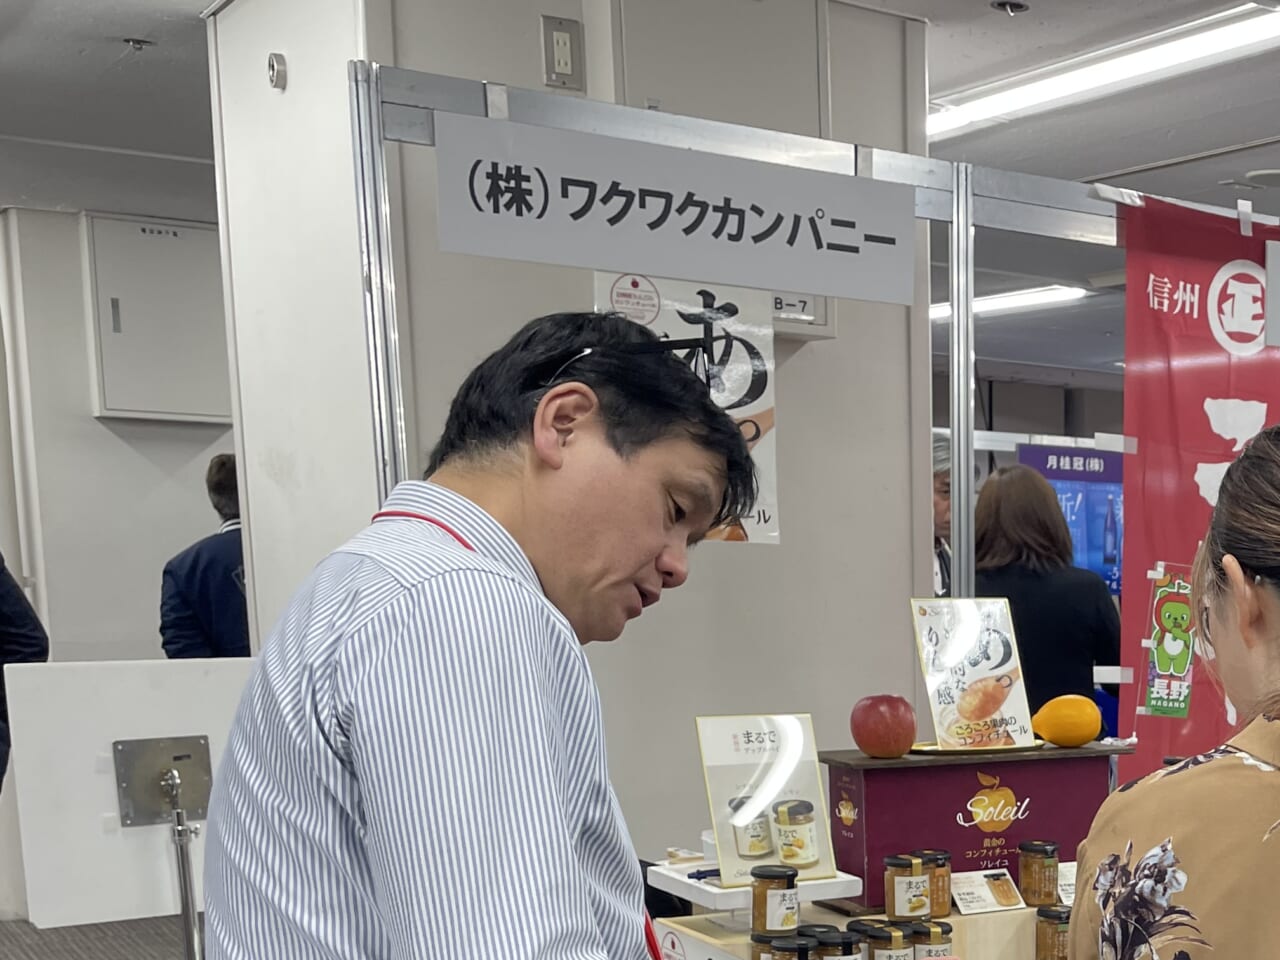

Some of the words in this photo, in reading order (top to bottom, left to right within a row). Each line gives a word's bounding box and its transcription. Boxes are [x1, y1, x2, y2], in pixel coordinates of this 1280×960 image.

[468, 159, 896, 255] (株)ワクワクカンパニー
[1146, 273, 1201, 319] 信州
[1150, 678, 1190, 701] 長野
[1150, 699, 1186, 709] NAGANO
[742, 730, 777, 745] まるで
[956, 797, 1031, 828] Soleil
